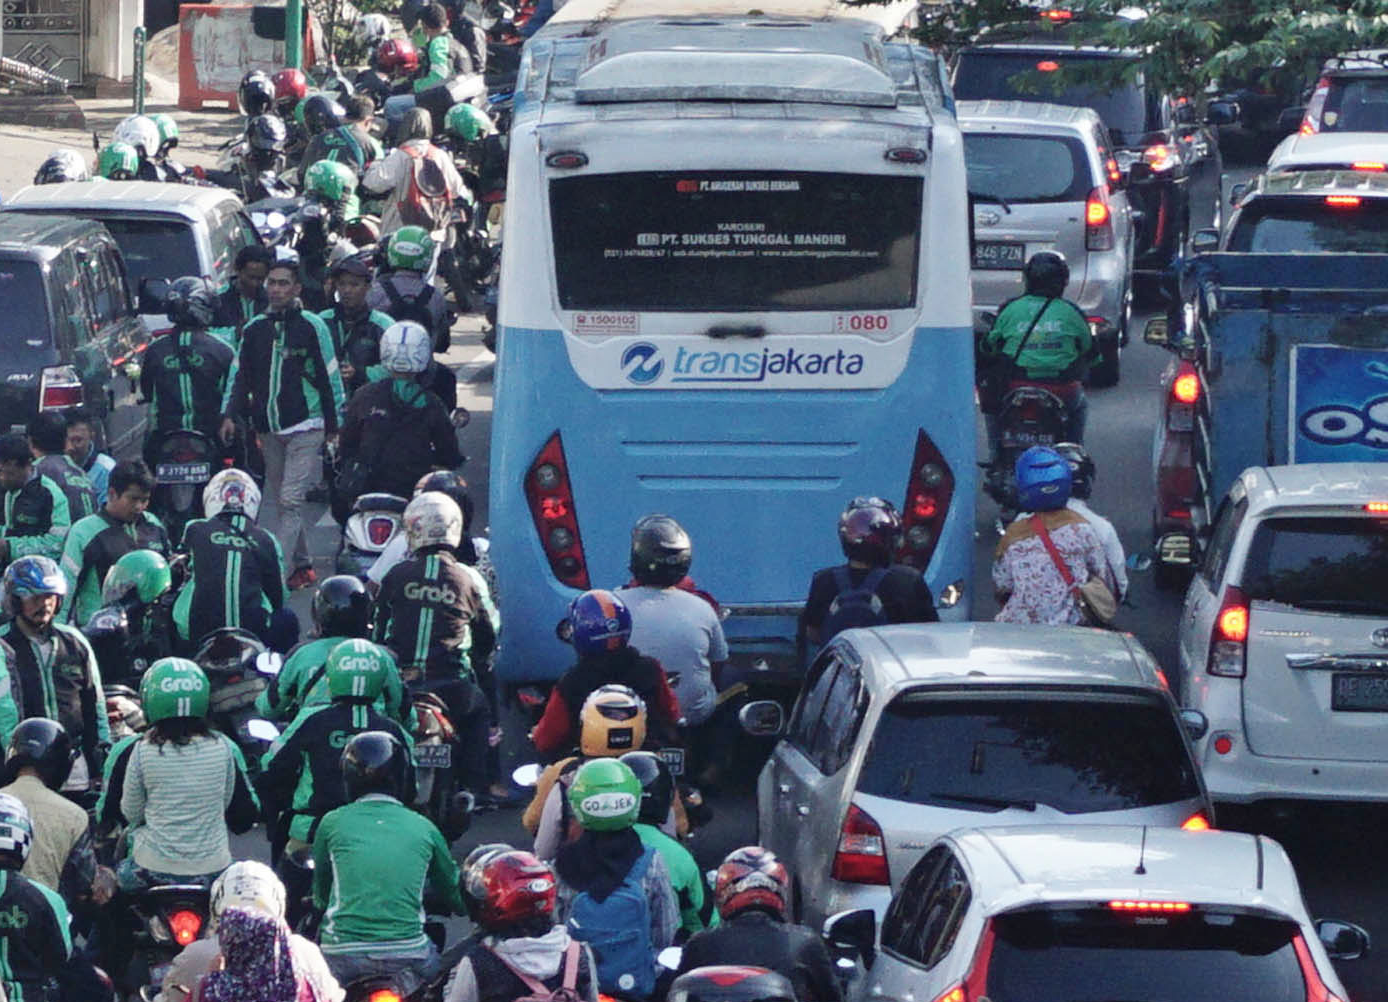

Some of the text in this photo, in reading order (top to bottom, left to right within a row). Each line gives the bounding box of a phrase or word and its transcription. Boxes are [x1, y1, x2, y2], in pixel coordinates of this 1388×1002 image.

[660, 234, 679, 246] PT.
[681, 234, 730, 246] SUKSES
[732, 234, 789, 246] TUNGGAL
[794, 234, 846, 246] MANDIRI
[850, 315, 888, 331] 080
[672, 346, 864, 382] transjakarta
[404, 581, 456, 605] Grab
[339, 654, 381, 672] Grab
[161, 673, 203, 693] Grab
